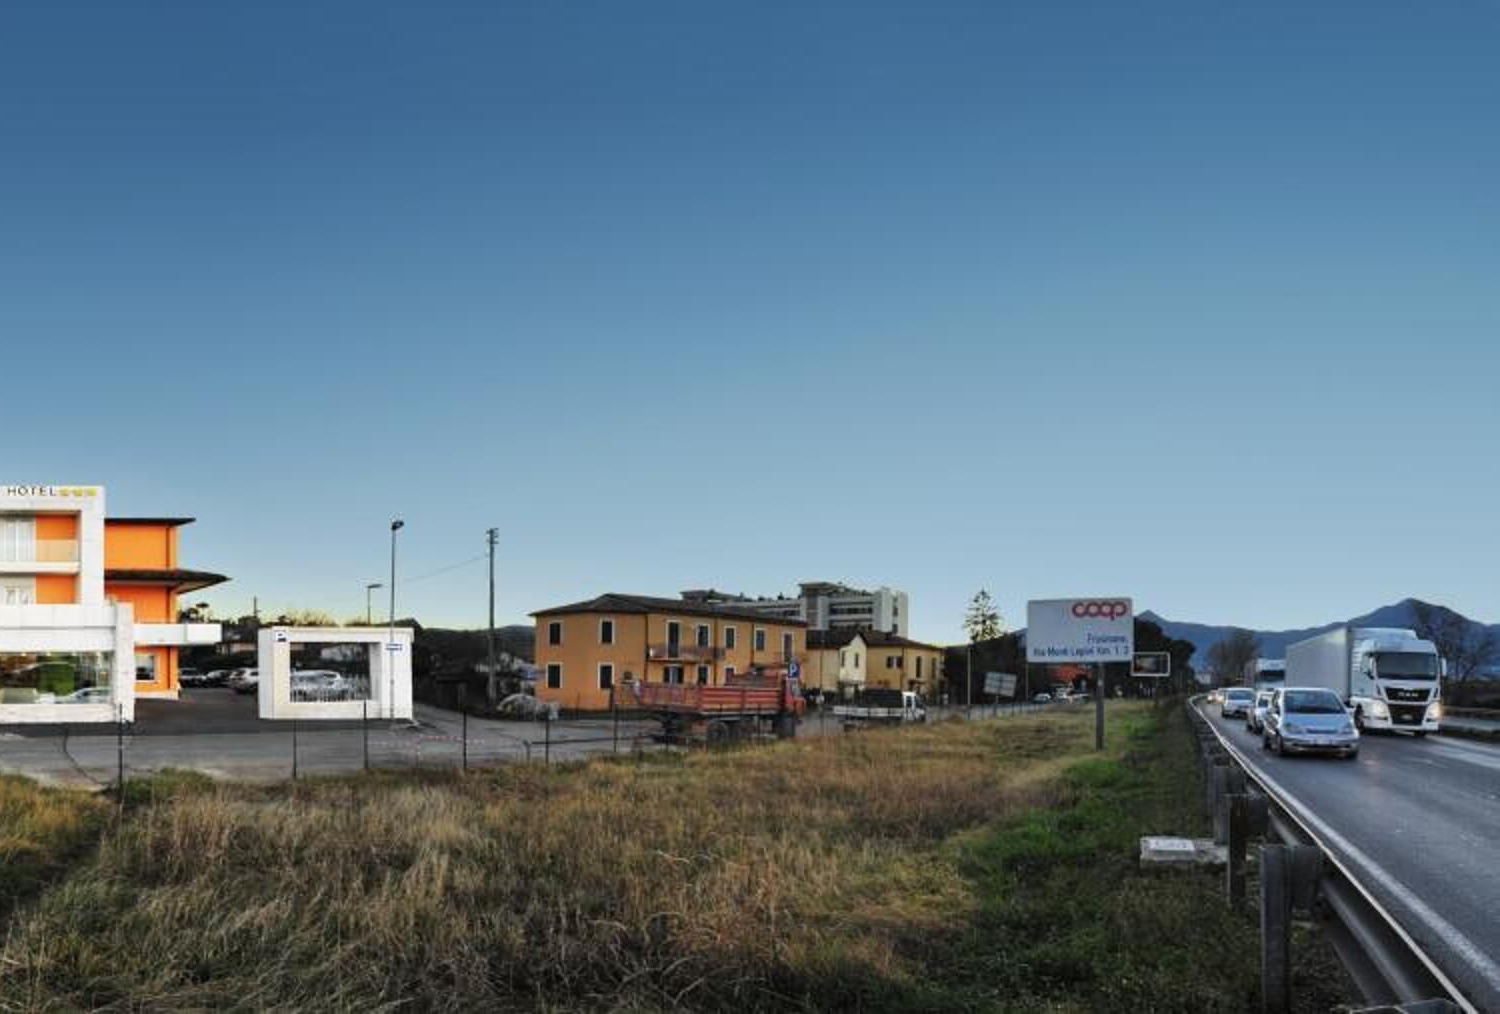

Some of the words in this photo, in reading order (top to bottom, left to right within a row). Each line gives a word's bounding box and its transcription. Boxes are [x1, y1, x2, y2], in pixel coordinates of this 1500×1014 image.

[7, 486, 57, 497] HOTEL
[1072, 602, 1127, 621] coop
[1033, 647, 1045, 657] Via
